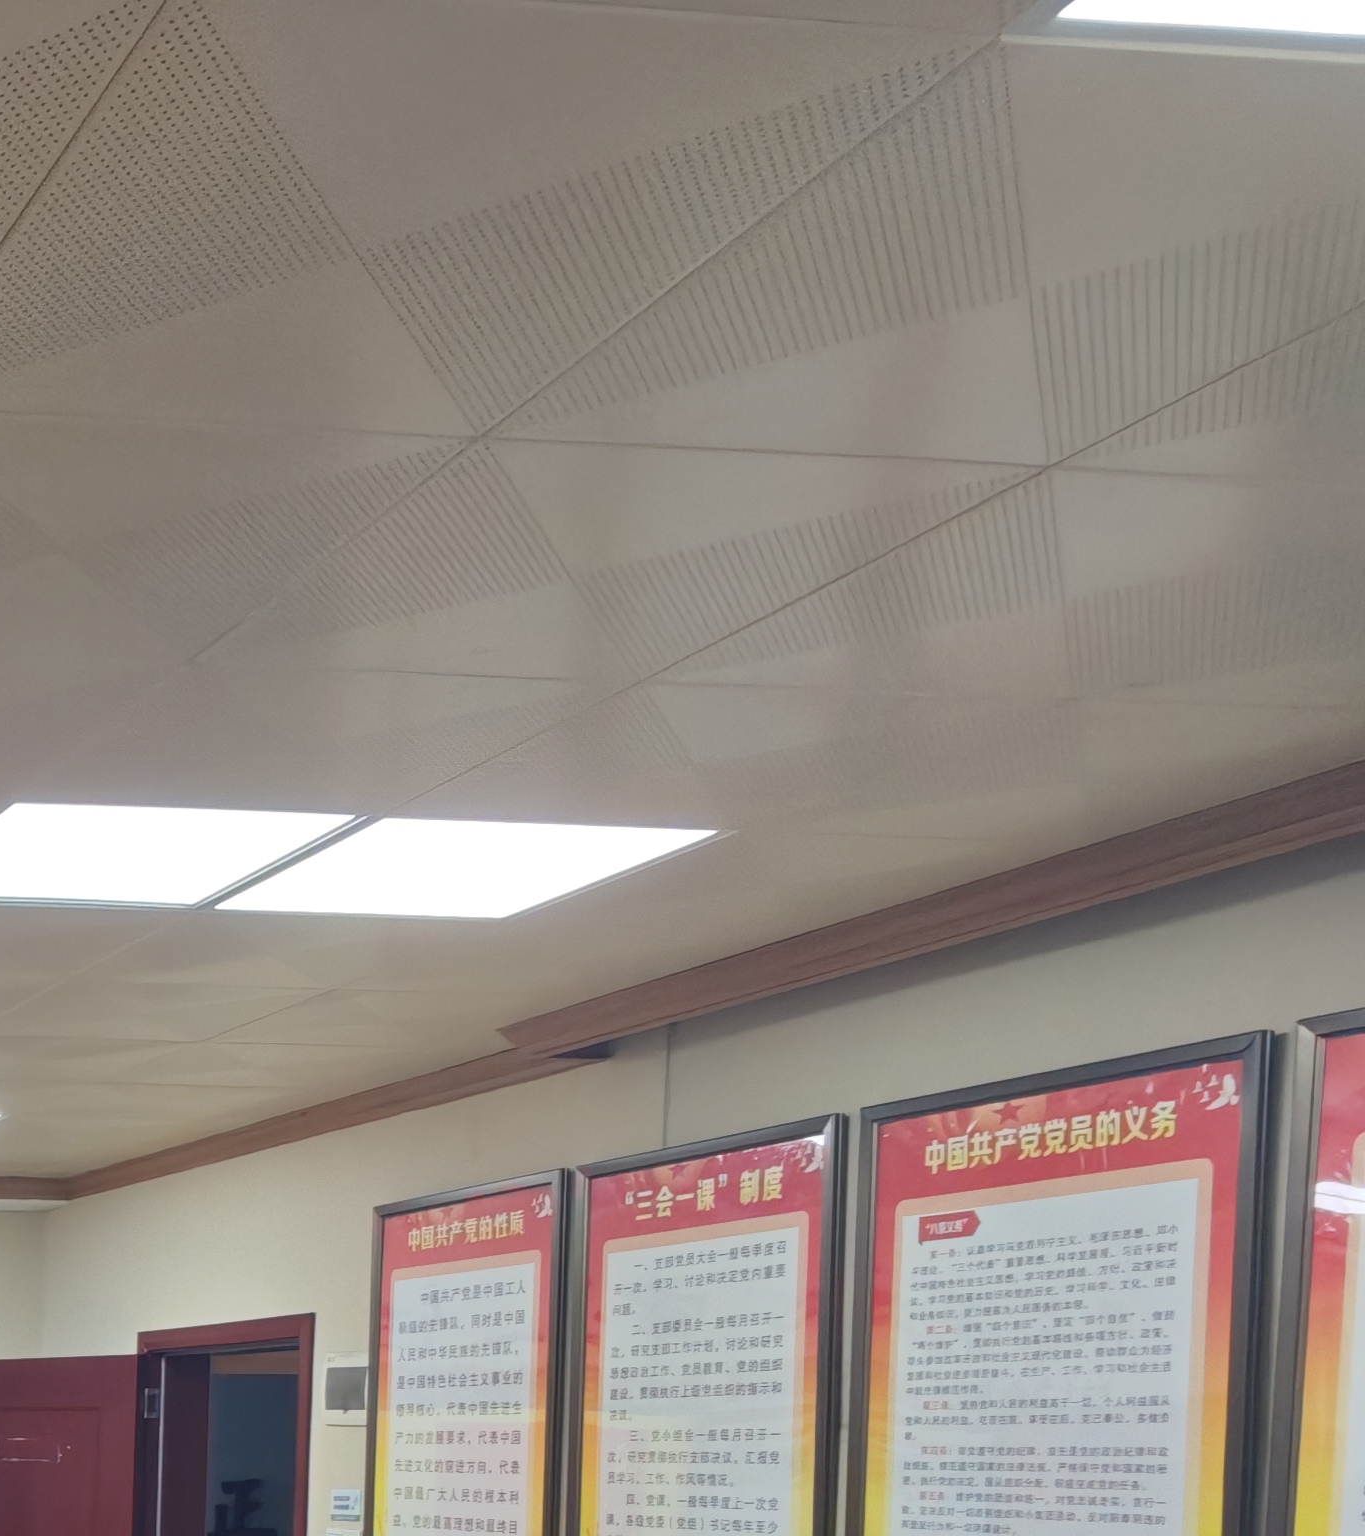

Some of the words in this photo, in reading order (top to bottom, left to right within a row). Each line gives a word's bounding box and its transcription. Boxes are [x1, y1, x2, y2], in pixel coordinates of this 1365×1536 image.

[925, 1100, 1178, 1175] 中国共产党党员的义务
[407, 1209, 526, 1252] 中国共产党的性质
